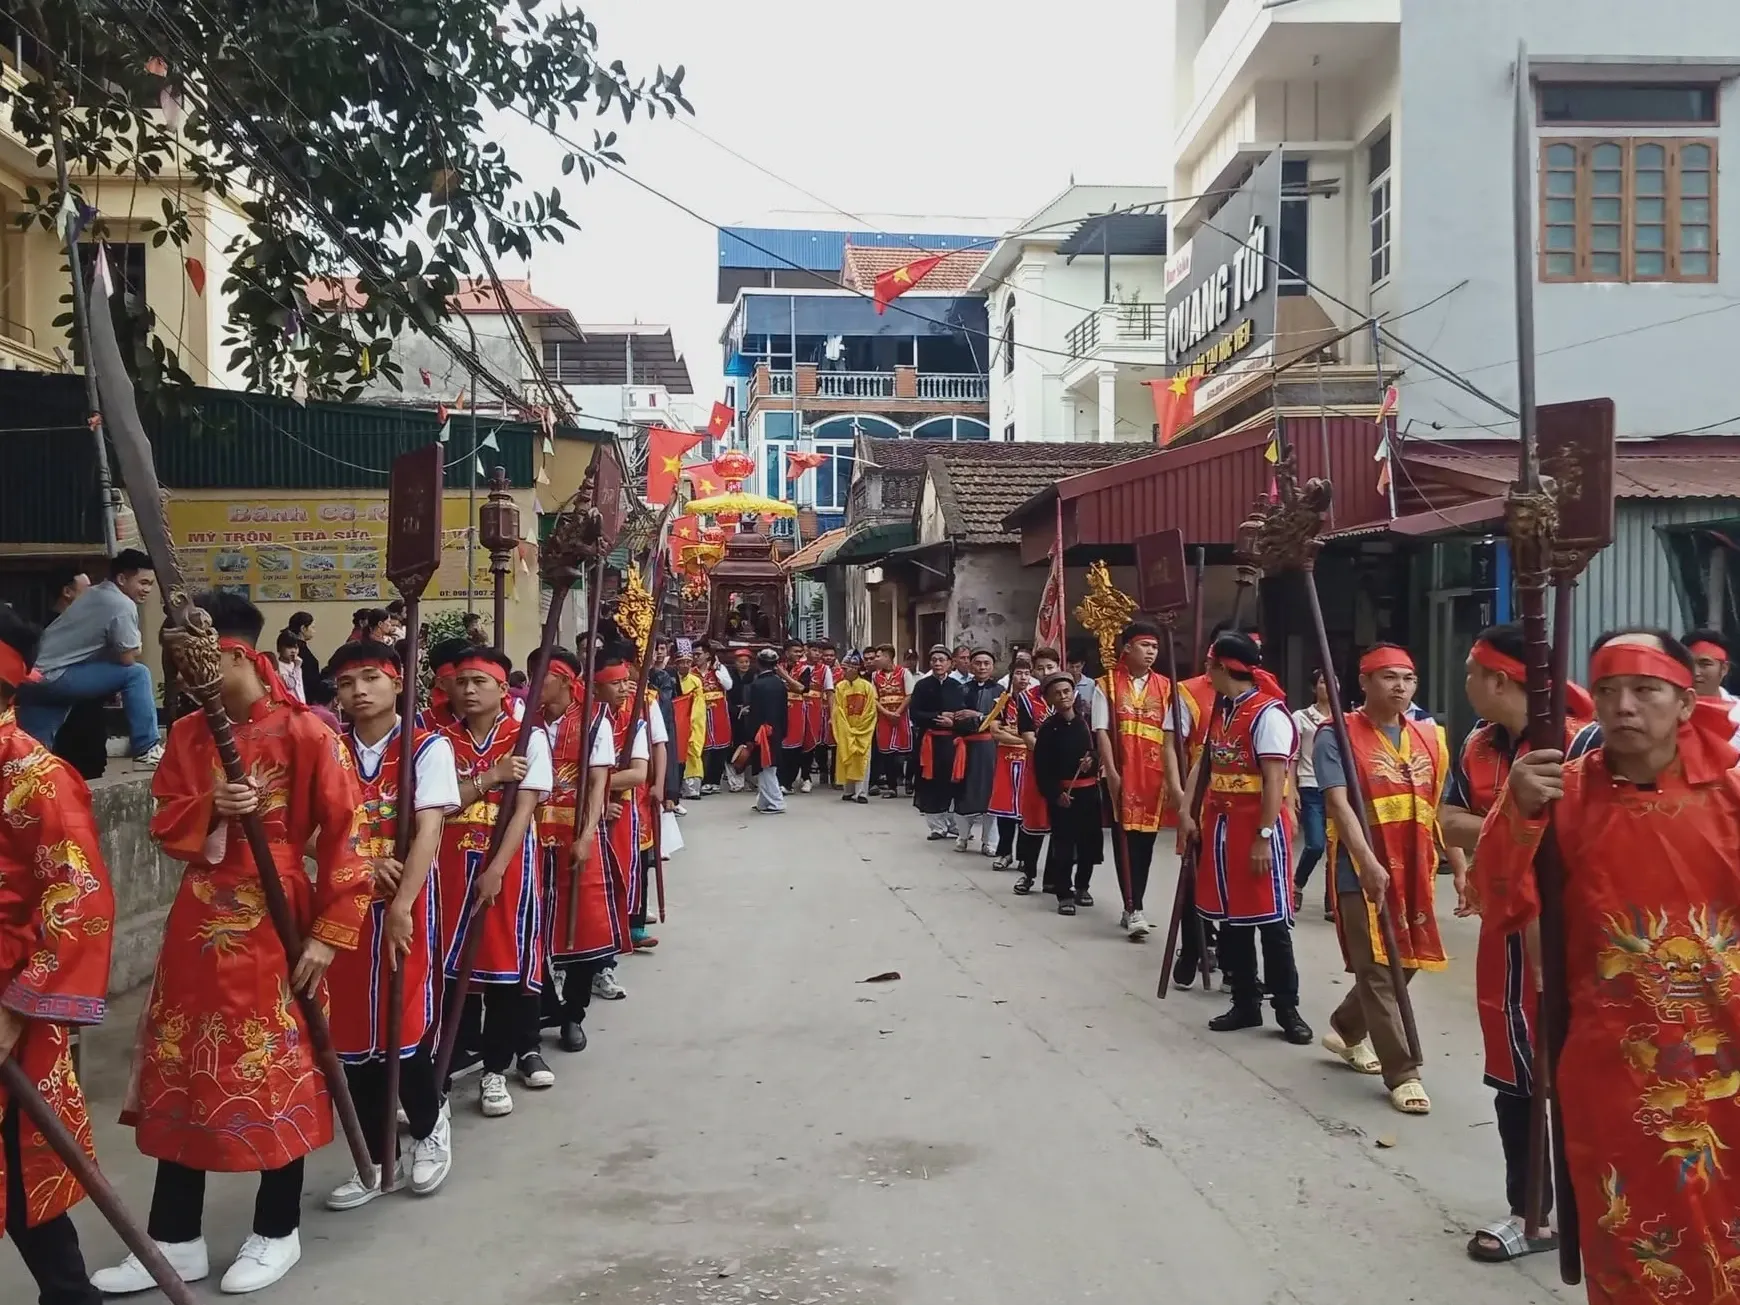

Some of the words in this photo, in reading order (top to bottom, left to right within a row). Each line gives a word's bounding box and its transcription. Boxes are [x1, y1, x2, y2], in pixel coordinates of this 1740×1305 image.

[1168, 264, 1228, 364] QUANG
[228, 504, 308, 522] Bánh
[223, 530, 272, 543] TRỘN
